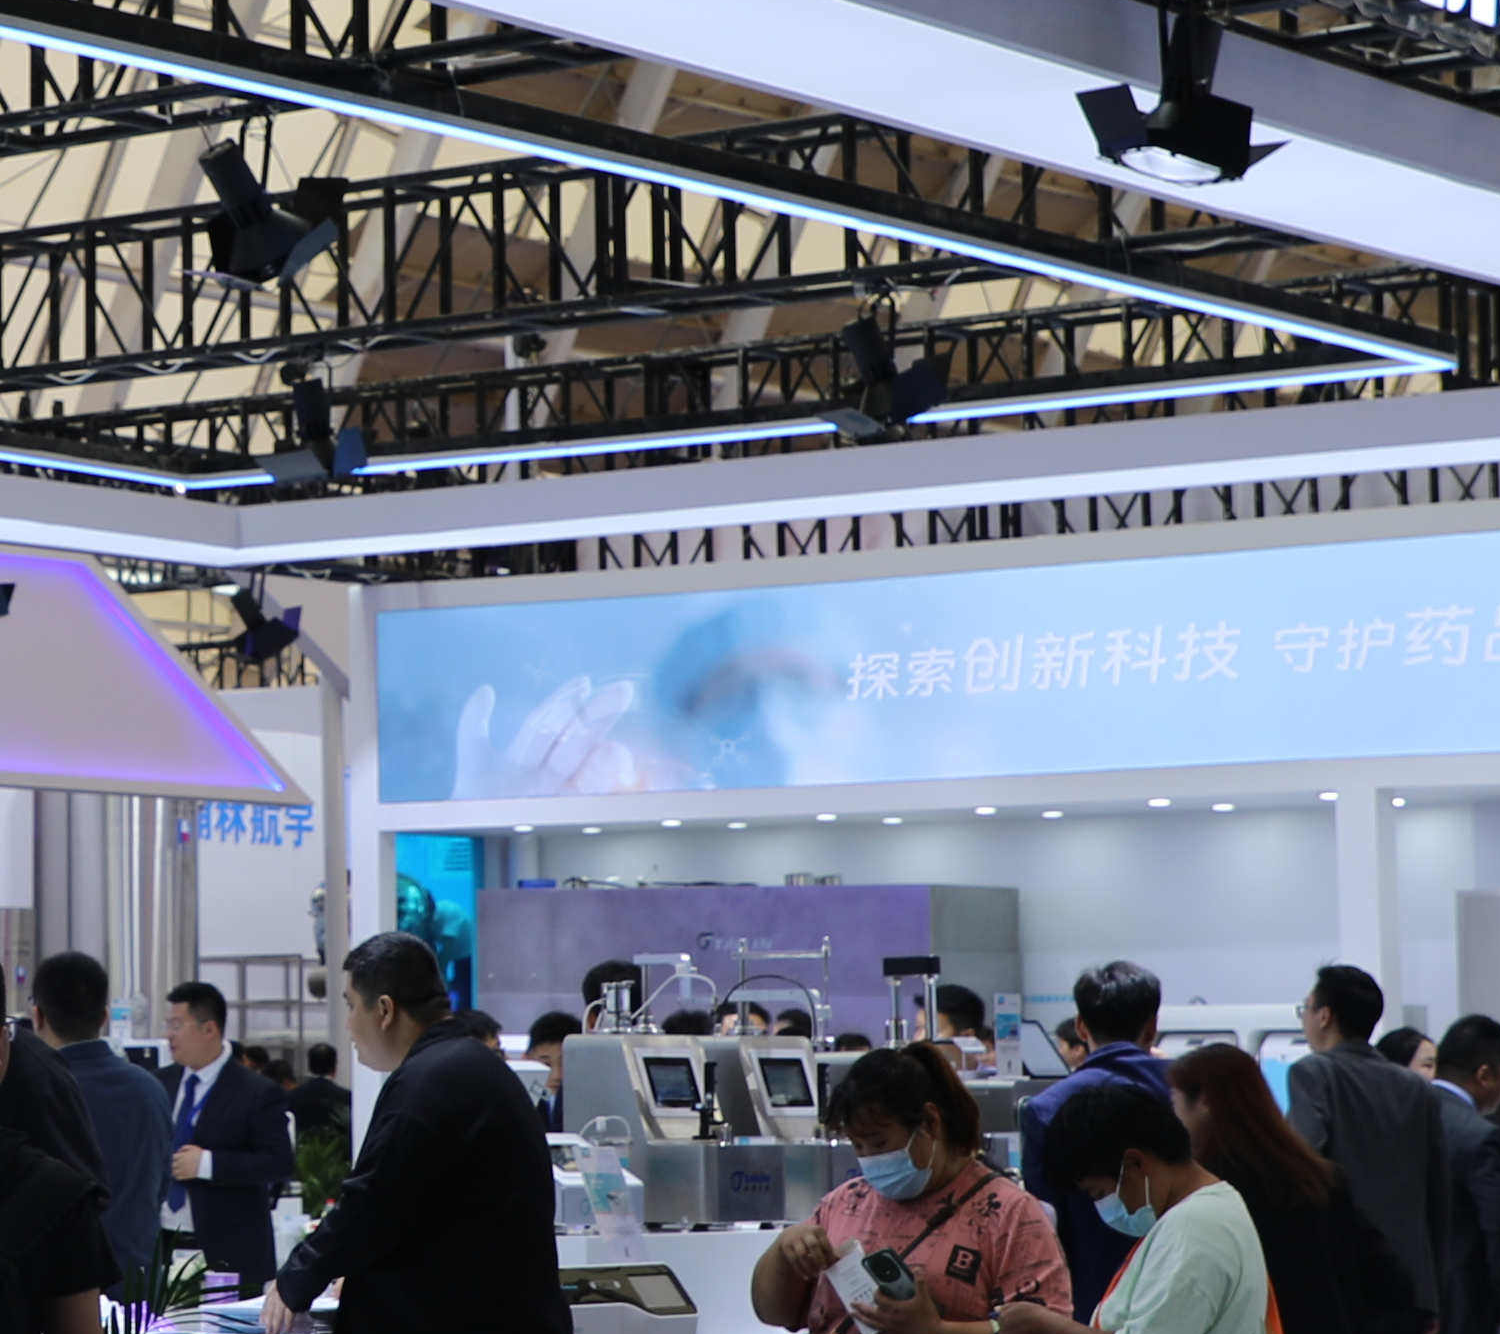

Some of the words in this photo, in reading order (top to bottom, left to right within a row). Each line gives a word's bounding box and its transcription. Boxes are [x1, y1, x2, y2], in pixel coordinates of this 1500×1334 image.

[845, 619, 1242, 704] 探索创新科技
